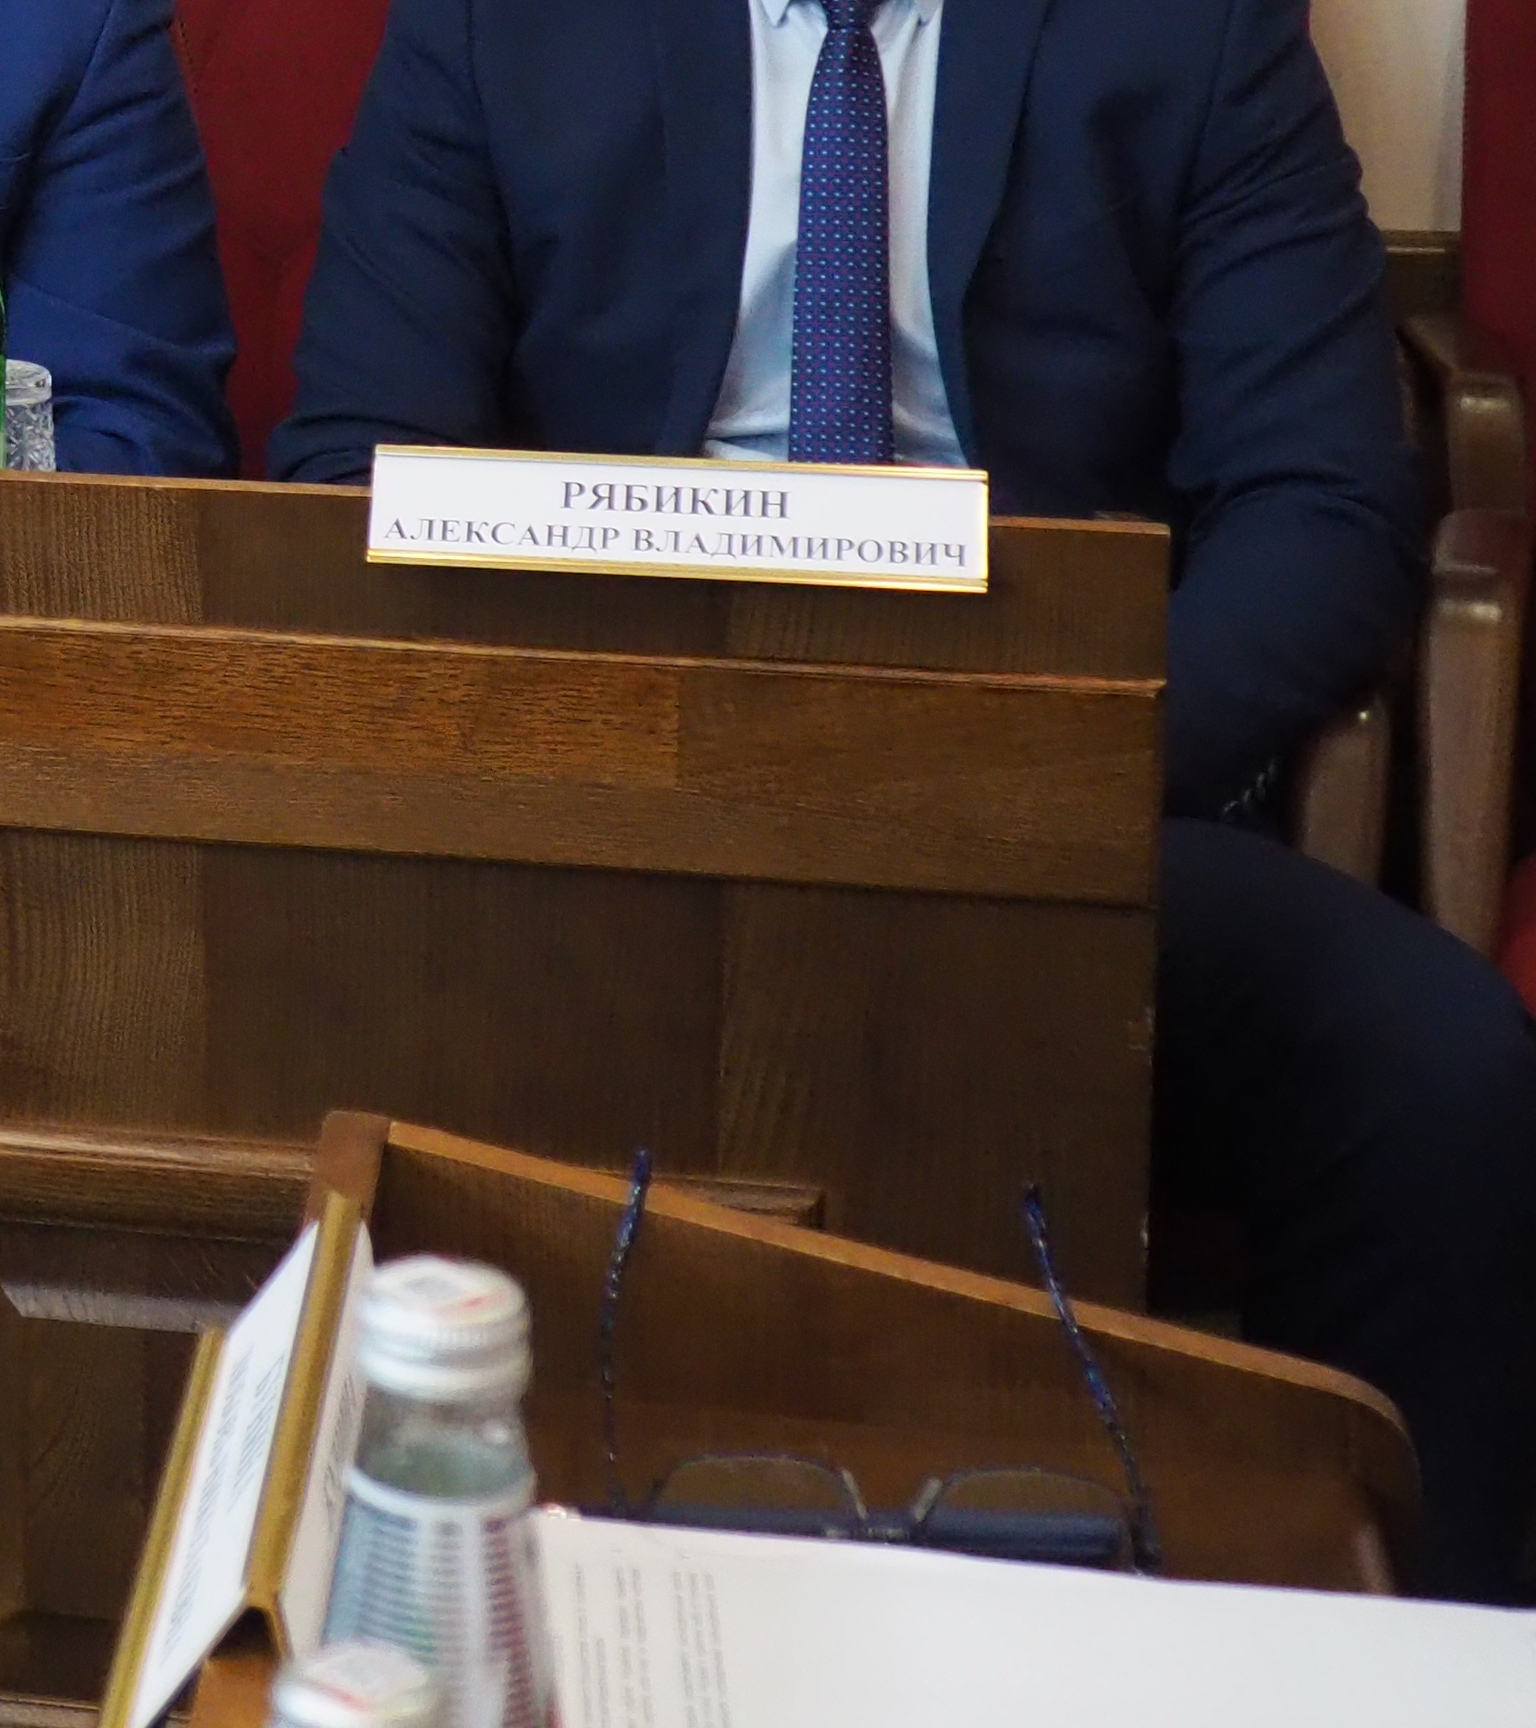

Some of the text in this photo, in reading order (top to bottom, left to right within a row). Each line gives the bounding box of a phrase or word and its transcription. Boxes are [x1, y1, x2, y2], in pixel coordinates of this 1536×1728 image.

[560, 480, 791, 519] РЯБИКИН
[384, 517, 969, 568] АЛЕКСАНДР ВЛАДИМИРОВИЧ
